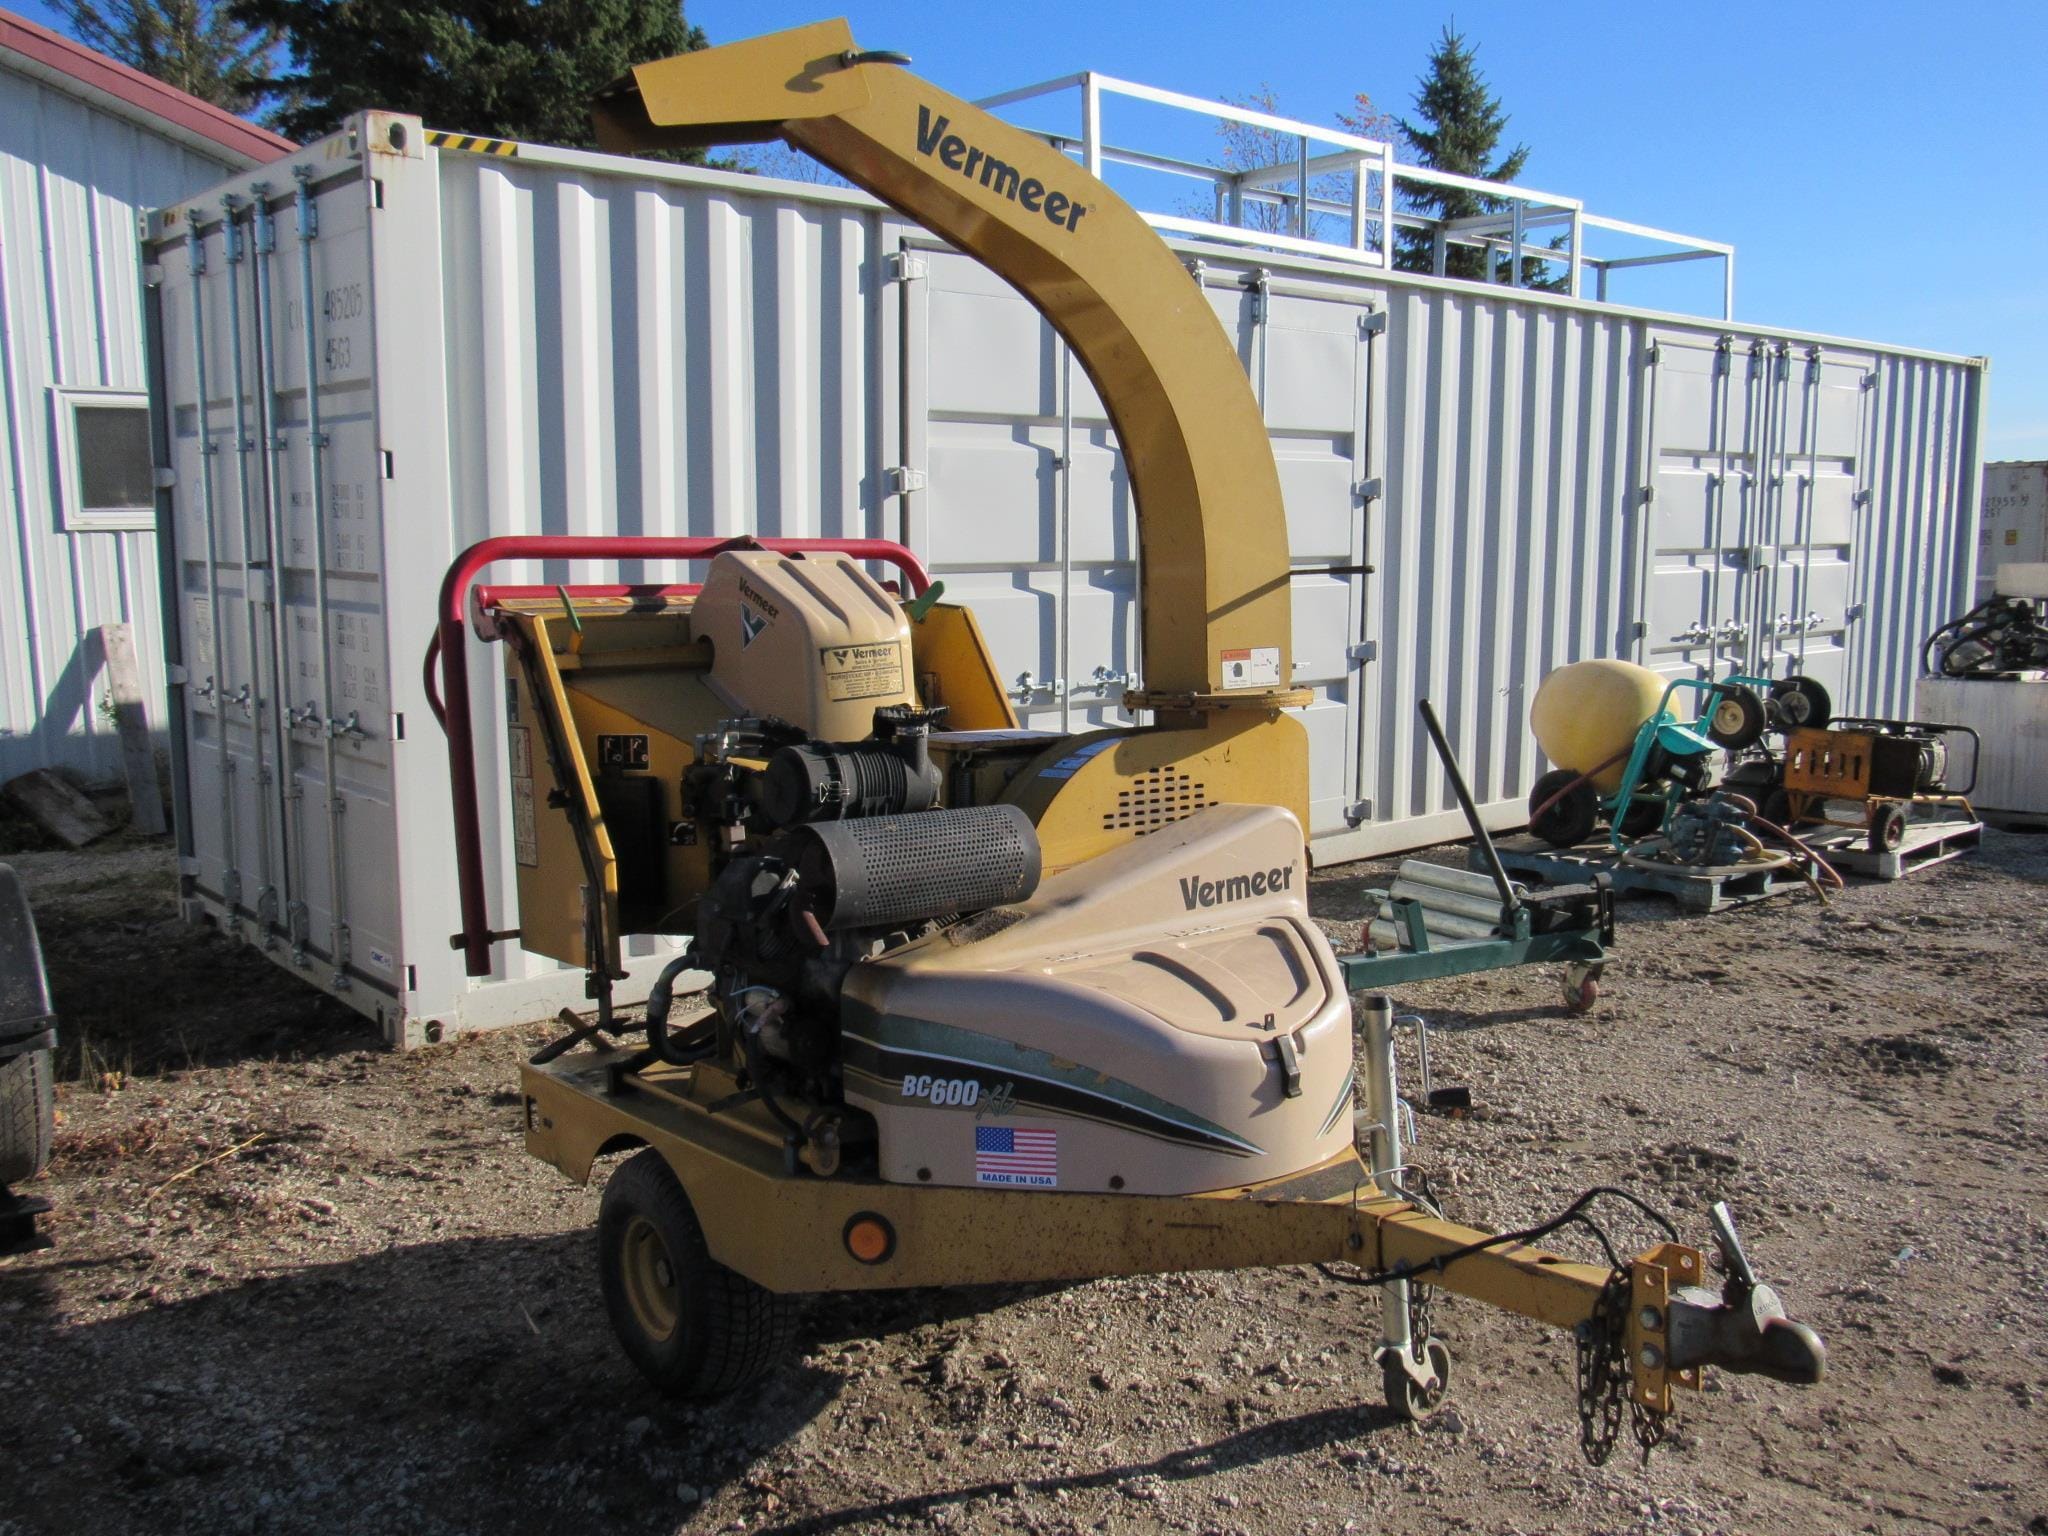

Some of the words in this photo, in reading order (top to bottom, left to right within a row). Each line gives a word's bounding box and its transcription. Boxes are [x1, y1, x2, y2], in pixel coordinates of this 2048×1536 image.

[917, 104, 1087, 233] Vermeer
[739, 576, 779, 619] Vermeer
[852, 647, 892, 659] Vermeer
[1179, 866, 1293, 911] Vermeer
[901, 1075, 980, 1106] BC600
[982, 1173, 1012, 1183] MADE
[1015, 1174, 1027, 1184] IN
[1030, 1175, 1052, 1185] USA
